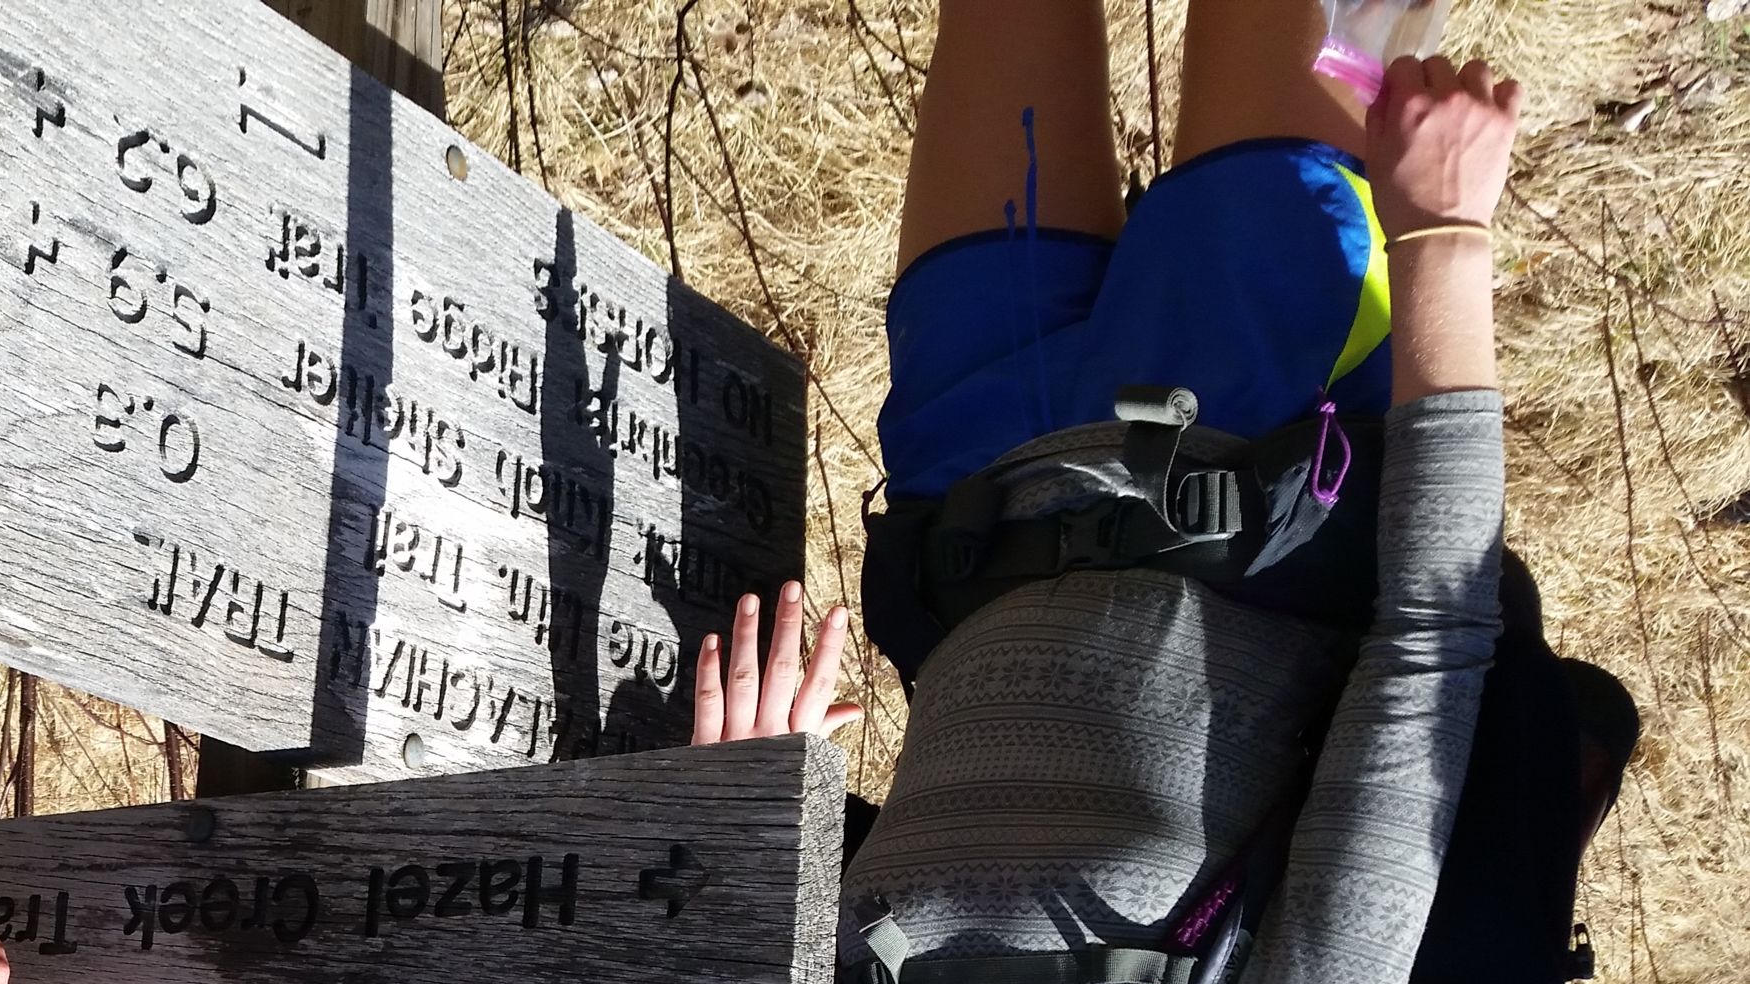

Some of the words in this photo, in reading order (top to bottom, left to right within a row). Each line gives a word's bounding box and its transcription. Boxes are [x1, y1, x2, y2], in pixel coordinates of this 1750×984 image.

[106, 246, 211, 361] 5.9
[409, 287, 540, 418] Ridge
[279, 339, 467, 490] Shelter
[131, 532, 295, 664] TRAIL
[362, 502, 468, 615] Trail
[607, 619, 678, 690] ote
[122, 873, 319, 951] Creek
[364, 853, 580, 938] Hazel
